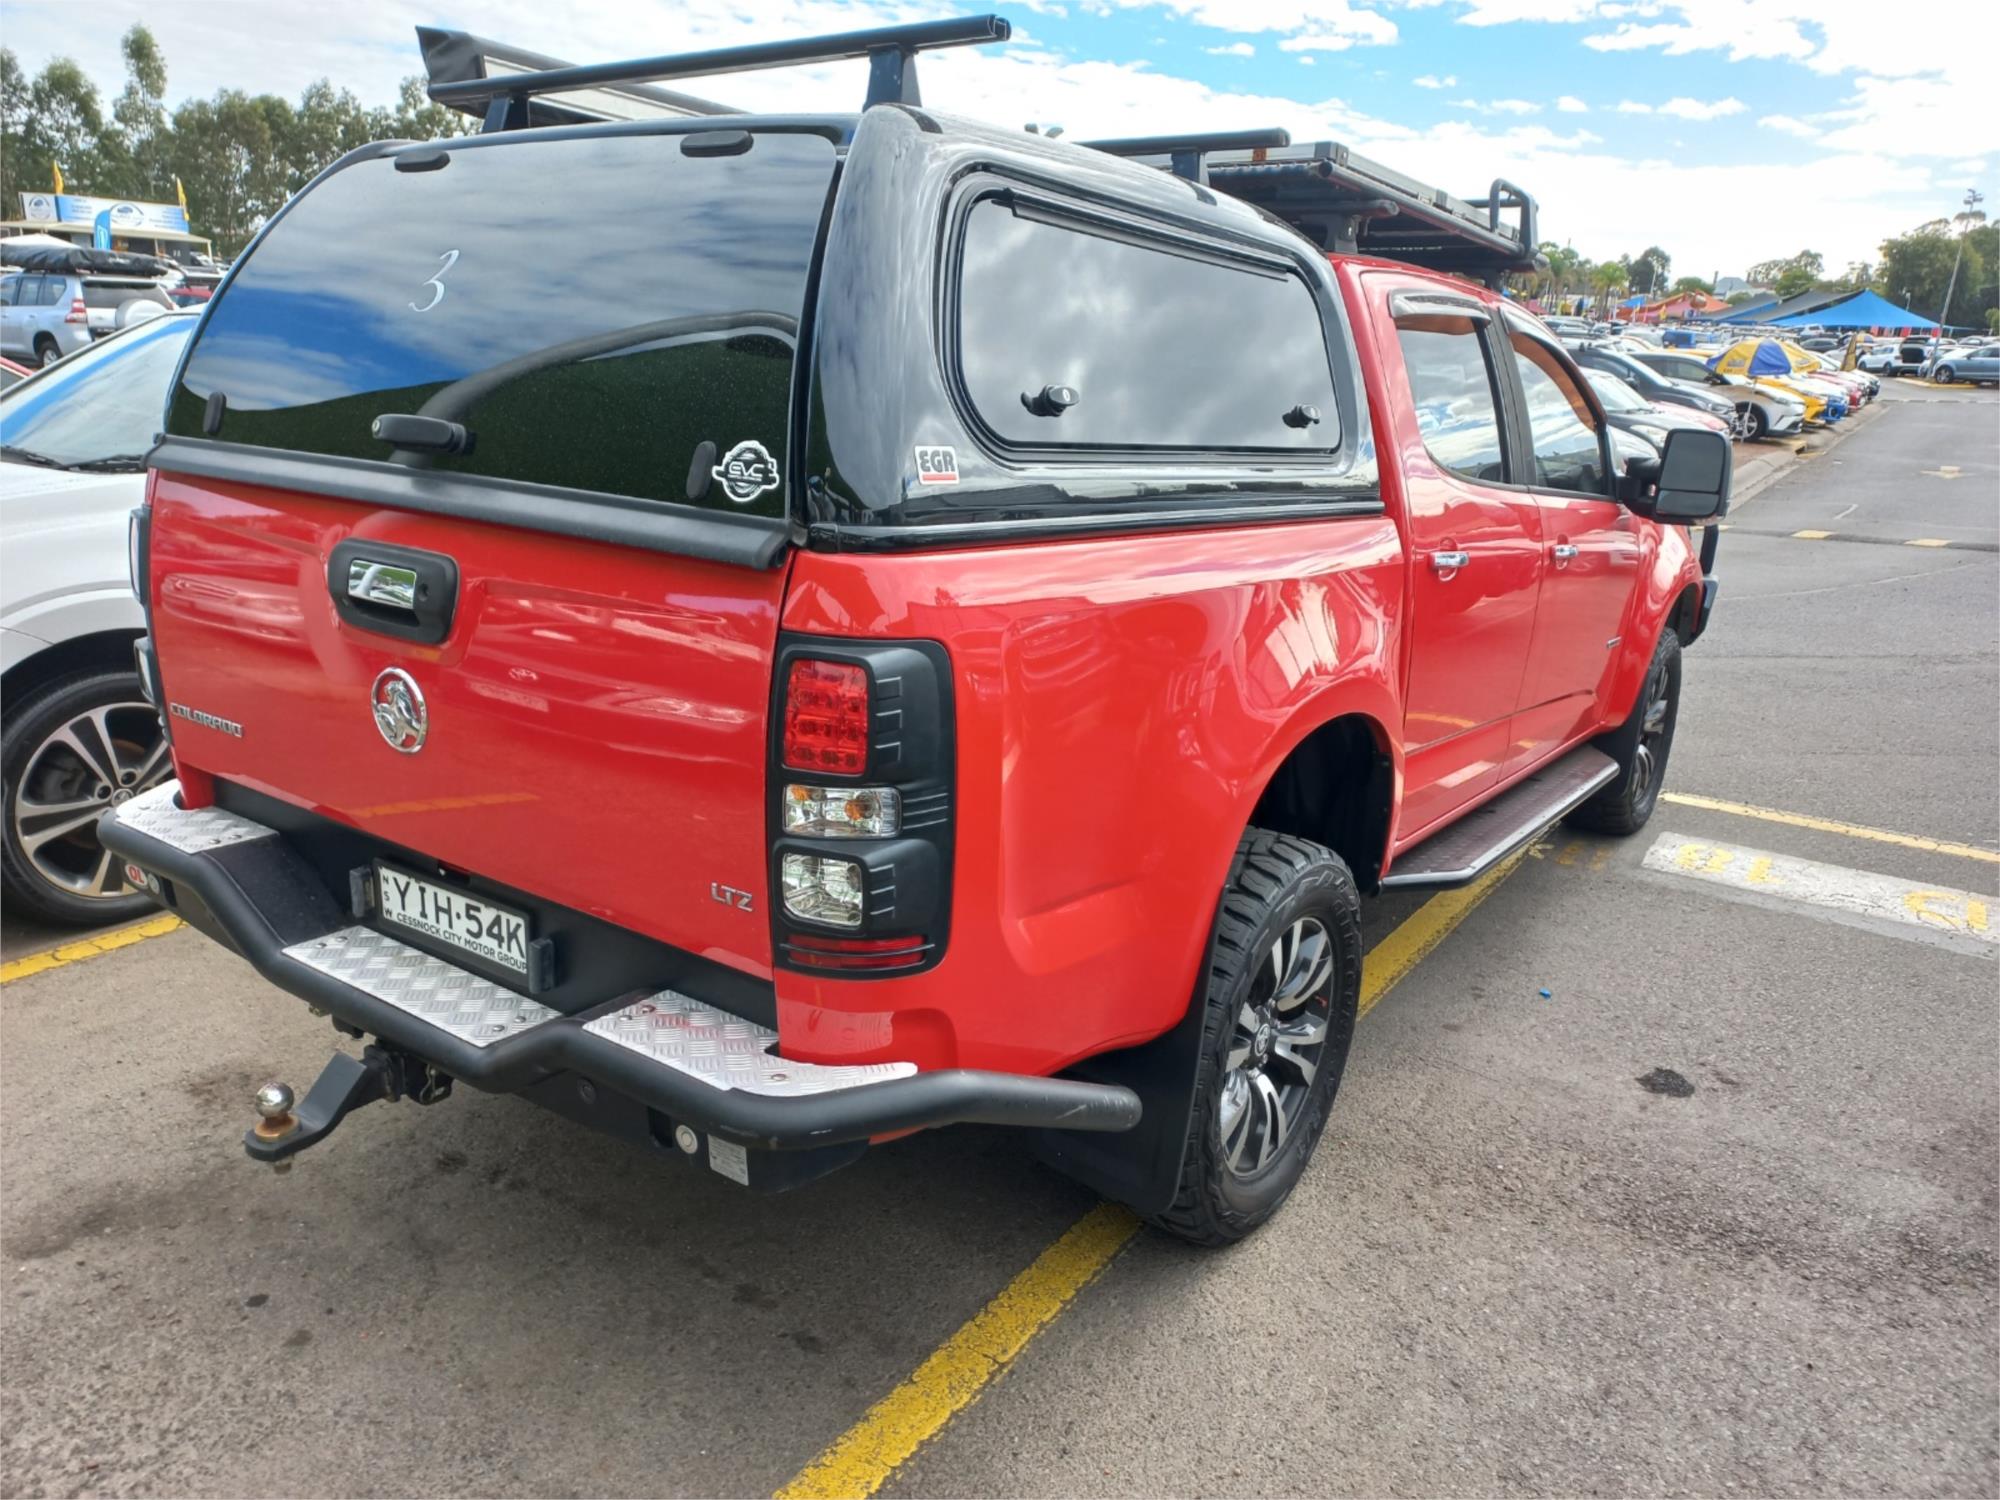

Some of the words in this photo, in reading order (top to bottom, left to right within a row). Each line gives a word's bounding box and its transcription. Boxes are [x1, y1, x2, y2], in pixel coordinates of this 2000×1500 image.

[408, 249, 460, 313] 3
[918, 449, 956, 473] EGR
[169, 702, 243, 738] COLORADO
[711, 882, 753, 912] LTZ
[396, 912, 442, 938] CESSNOCK
[442, 930, 463, 947] CITY
[464, 937, 496, 961] MOTOR
[497, 951, 528, 973] GROUP
